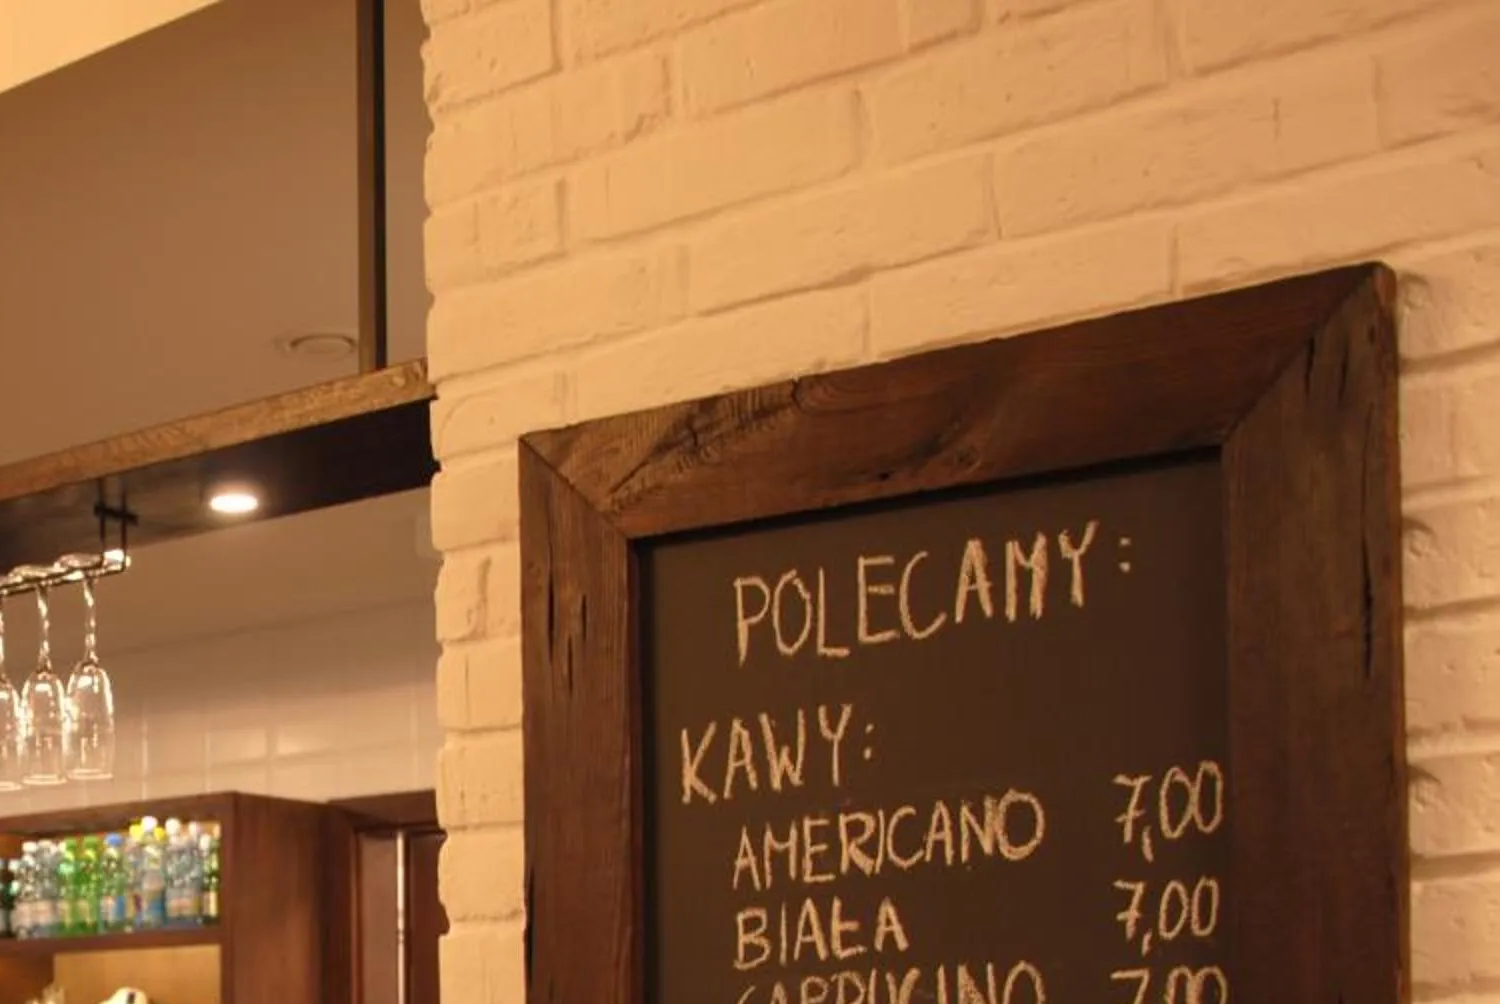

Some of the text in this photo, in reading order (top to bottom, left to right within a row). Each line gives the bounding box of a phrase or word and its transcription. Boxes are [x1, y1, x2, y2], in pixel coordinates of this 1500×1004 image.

[730, 518, 1134, 667] POLECAMY:
[678, 702, 878, 806] KAWY:
[731, 758, 1226, 892] AMERICANO 7,00
[732, 876, 1222, 971] BIAŁA 7,00
